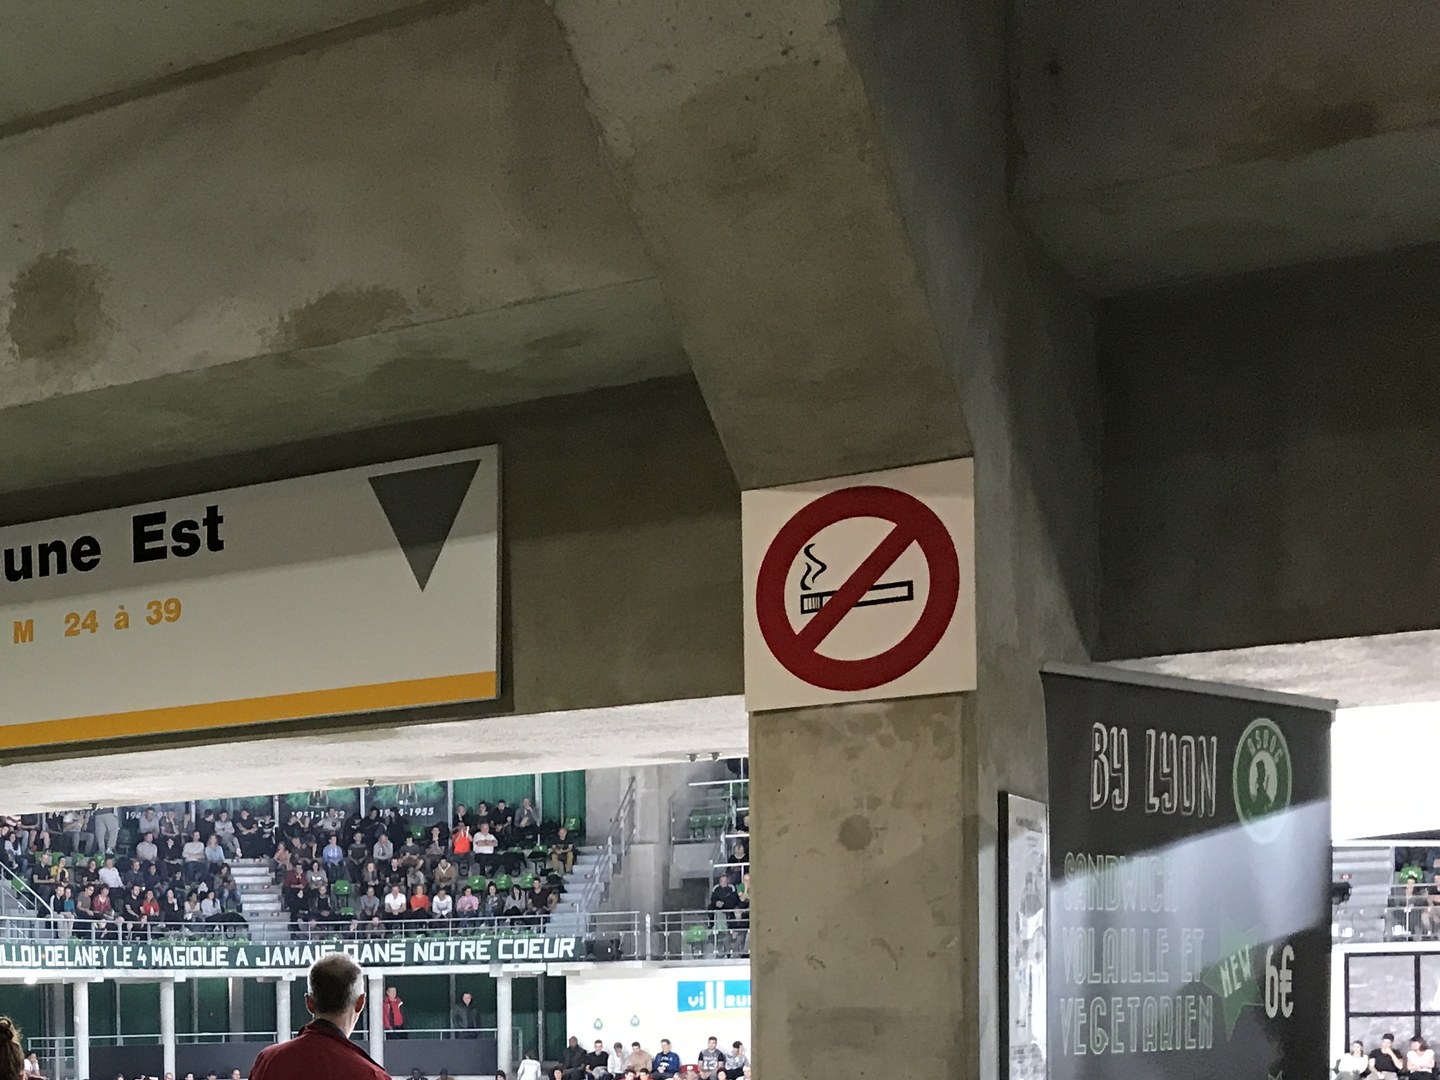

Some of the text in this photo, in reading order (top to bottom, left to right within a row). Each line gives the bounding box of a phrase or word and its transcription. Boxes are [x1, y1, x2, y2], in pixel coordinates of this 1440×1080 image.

[132, 505, 224, 563] Est
[13, 619, 34, 644] M
[64, 610, 99, 637] 24
[114, 605, 130, 630] à
[146, 597, 182, 625] 39
[113, 946, 133, 967] LE
[136, 946, 147, 967] 4
[151, 945, 229, 967] MAGIQUE
[235, 947, 246, 967] A
[413, 939, 491, 963] NOTRE
[497, 937, 576, 960] COEUR
[1062, 927, 1205, 985] VOLAILLE ET
[1219, 943, 1253, 999] NEW
[1264, 944, 1295, 1019] 6€
[1060, 995, 1213, 1056] VEGETARIEN
